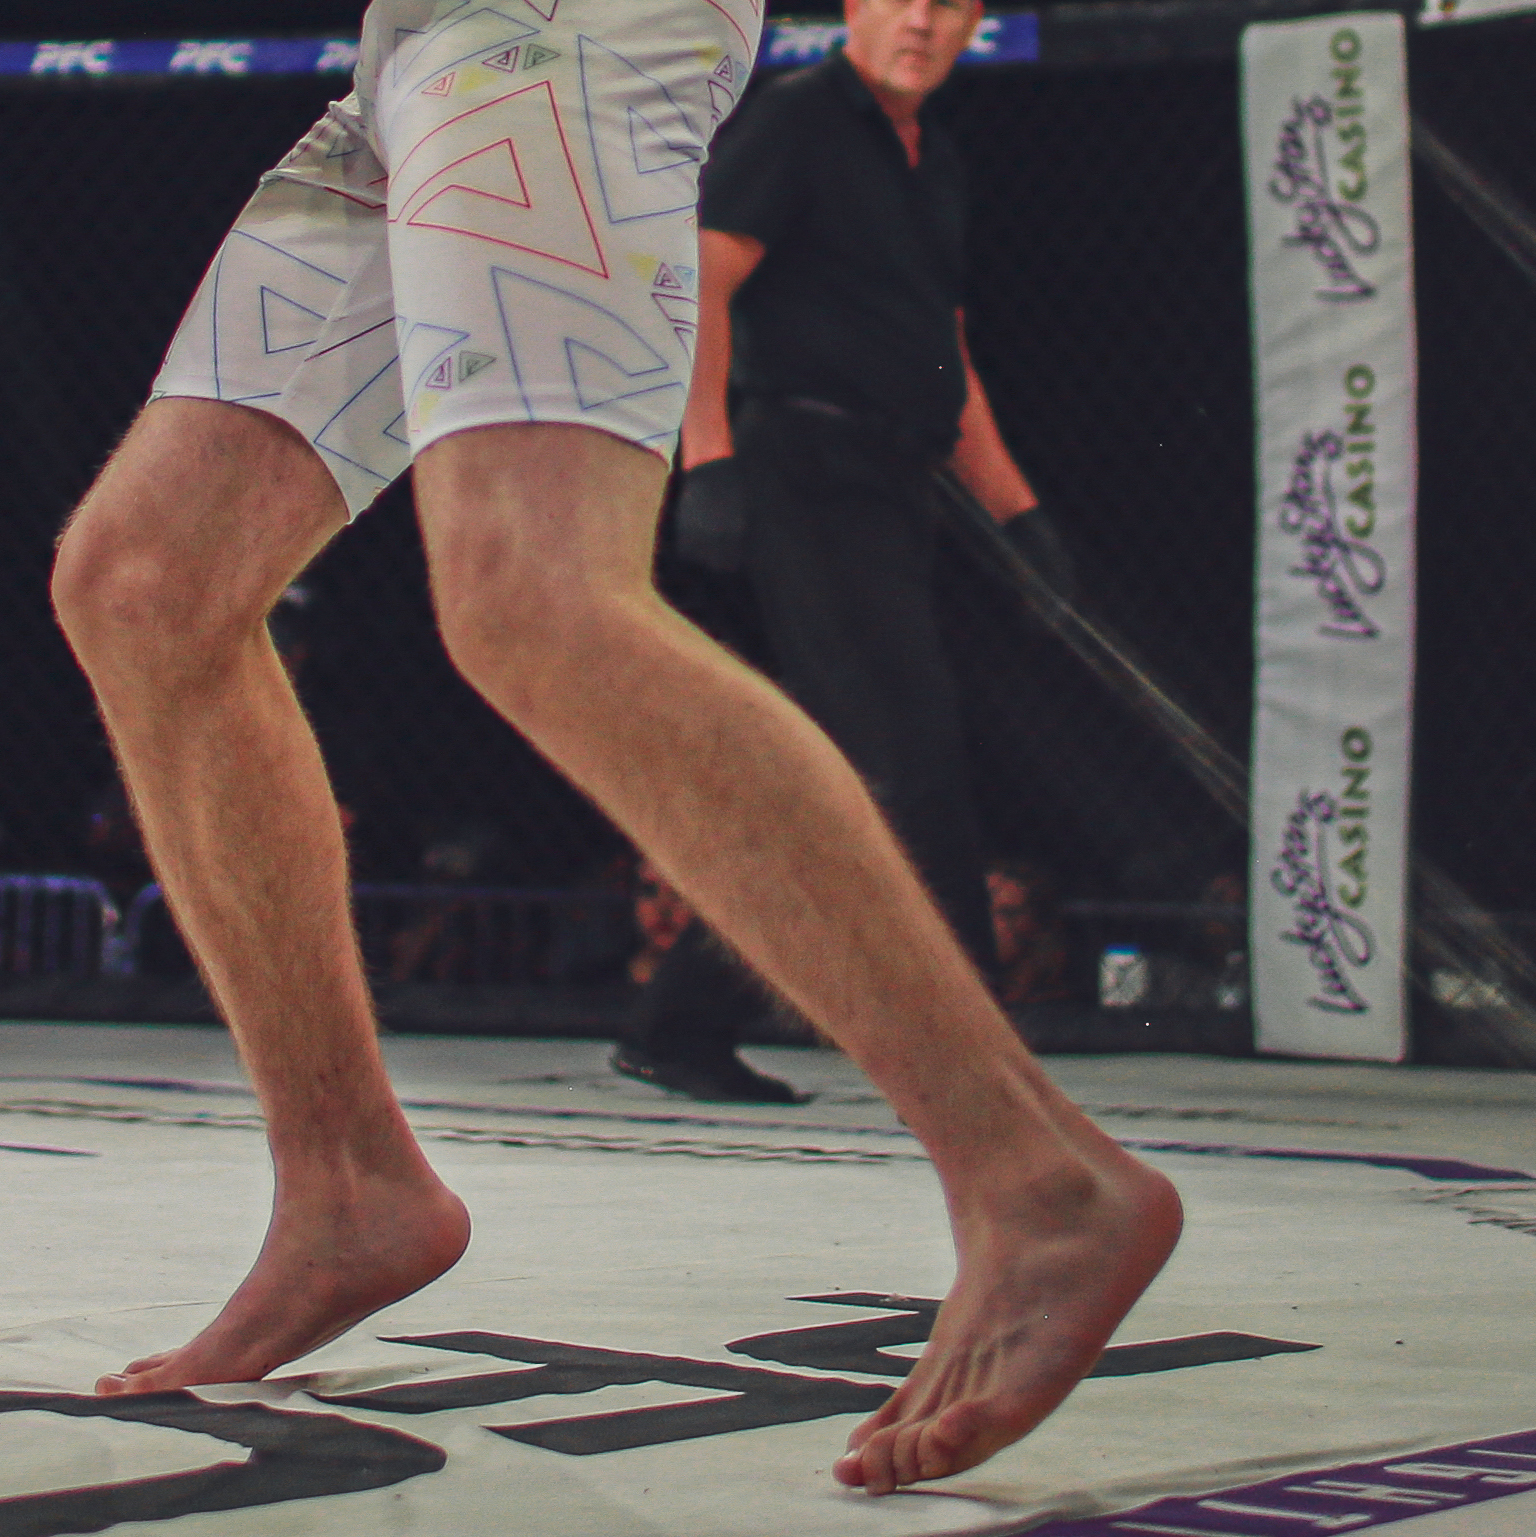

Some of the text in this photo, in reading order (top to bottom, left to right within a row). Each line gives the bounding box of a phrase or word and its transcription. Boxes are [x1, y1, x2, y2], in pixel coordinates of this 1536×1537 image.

[1329, 27, 1371, 204] CASINO
[1343, 363, 1378, 540] CASINO
[1337, 725, 1373, 910] CASINO
